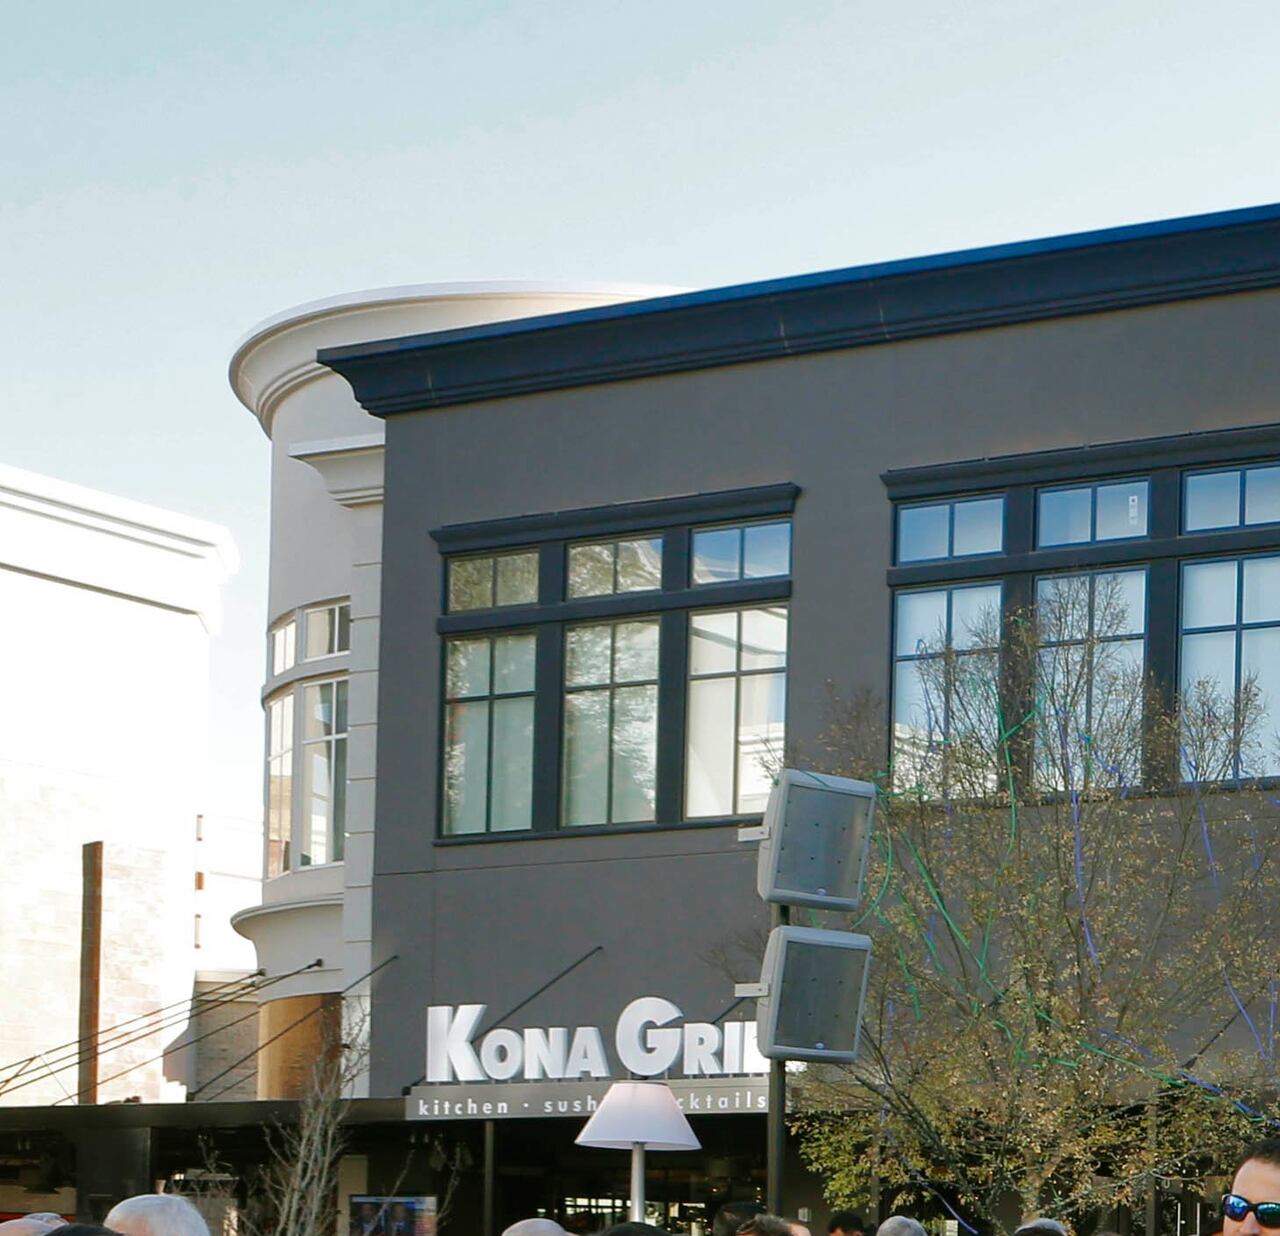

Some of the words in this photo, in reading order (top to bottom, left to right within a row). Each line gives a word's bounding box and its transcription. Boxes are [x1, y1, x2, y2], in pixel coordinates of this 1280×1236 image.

[426, 1004, 610, 1083] KONA
[615, 997, 807, 1076] GRIL
[418, 1099, 508, 1115] kitchen
[544, 1094, 604, 1113] sush
[676, 1091, 767, 1110] cktails
